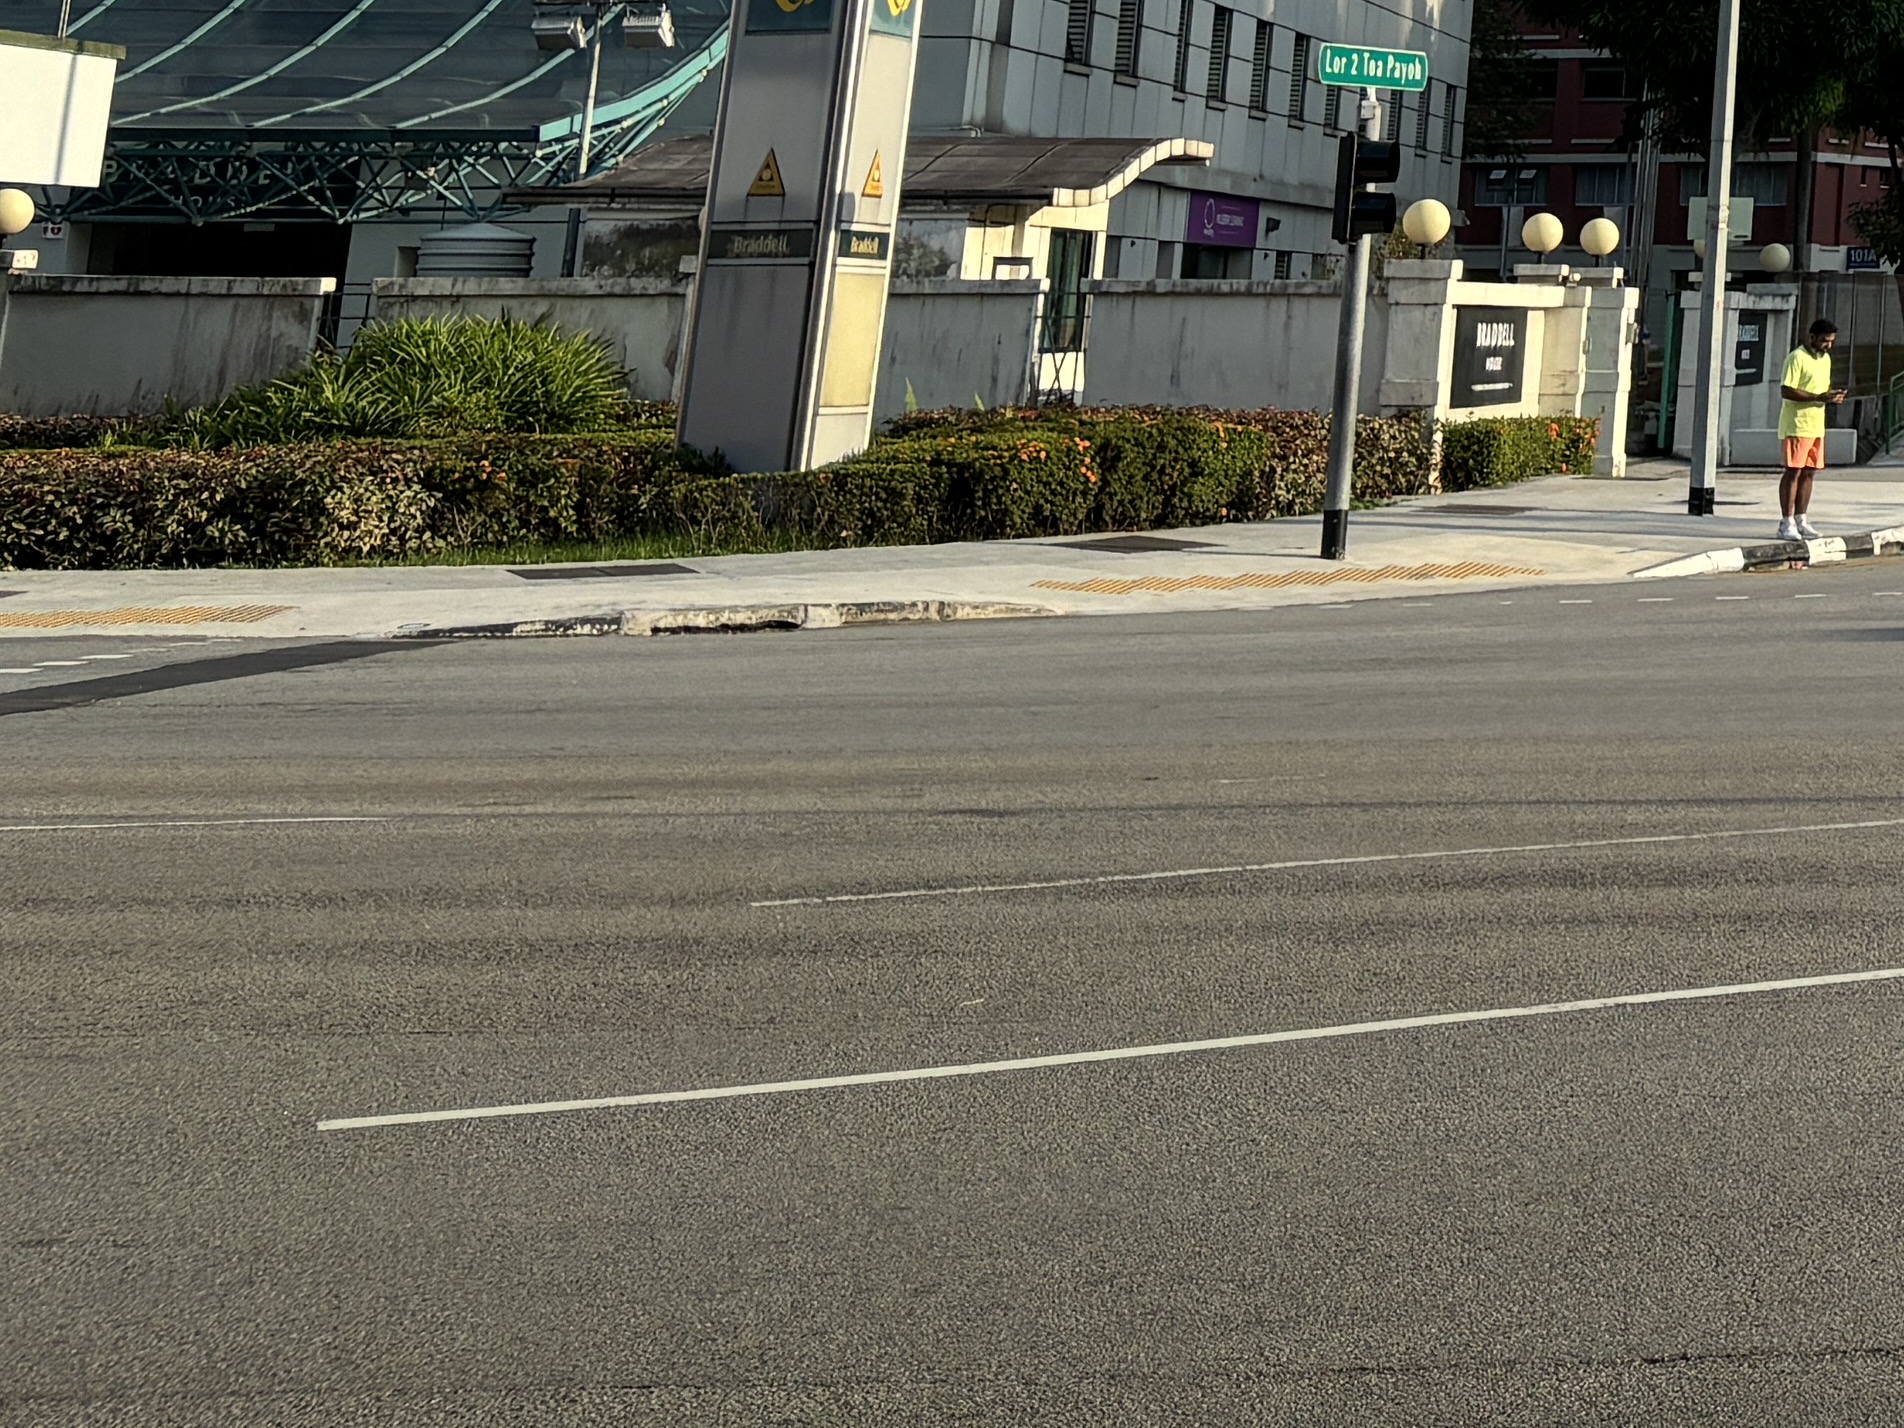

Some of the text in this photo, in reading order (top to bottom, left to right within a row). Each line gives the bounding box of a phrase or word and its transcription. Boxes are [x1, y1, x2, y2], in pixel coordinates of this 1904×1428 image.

[1325, 48, 1422, 85] Lor 2 Toa Payoh
[734, 233, 790, 256] Braddell
[1850, 248, 1877, 263] 101A
